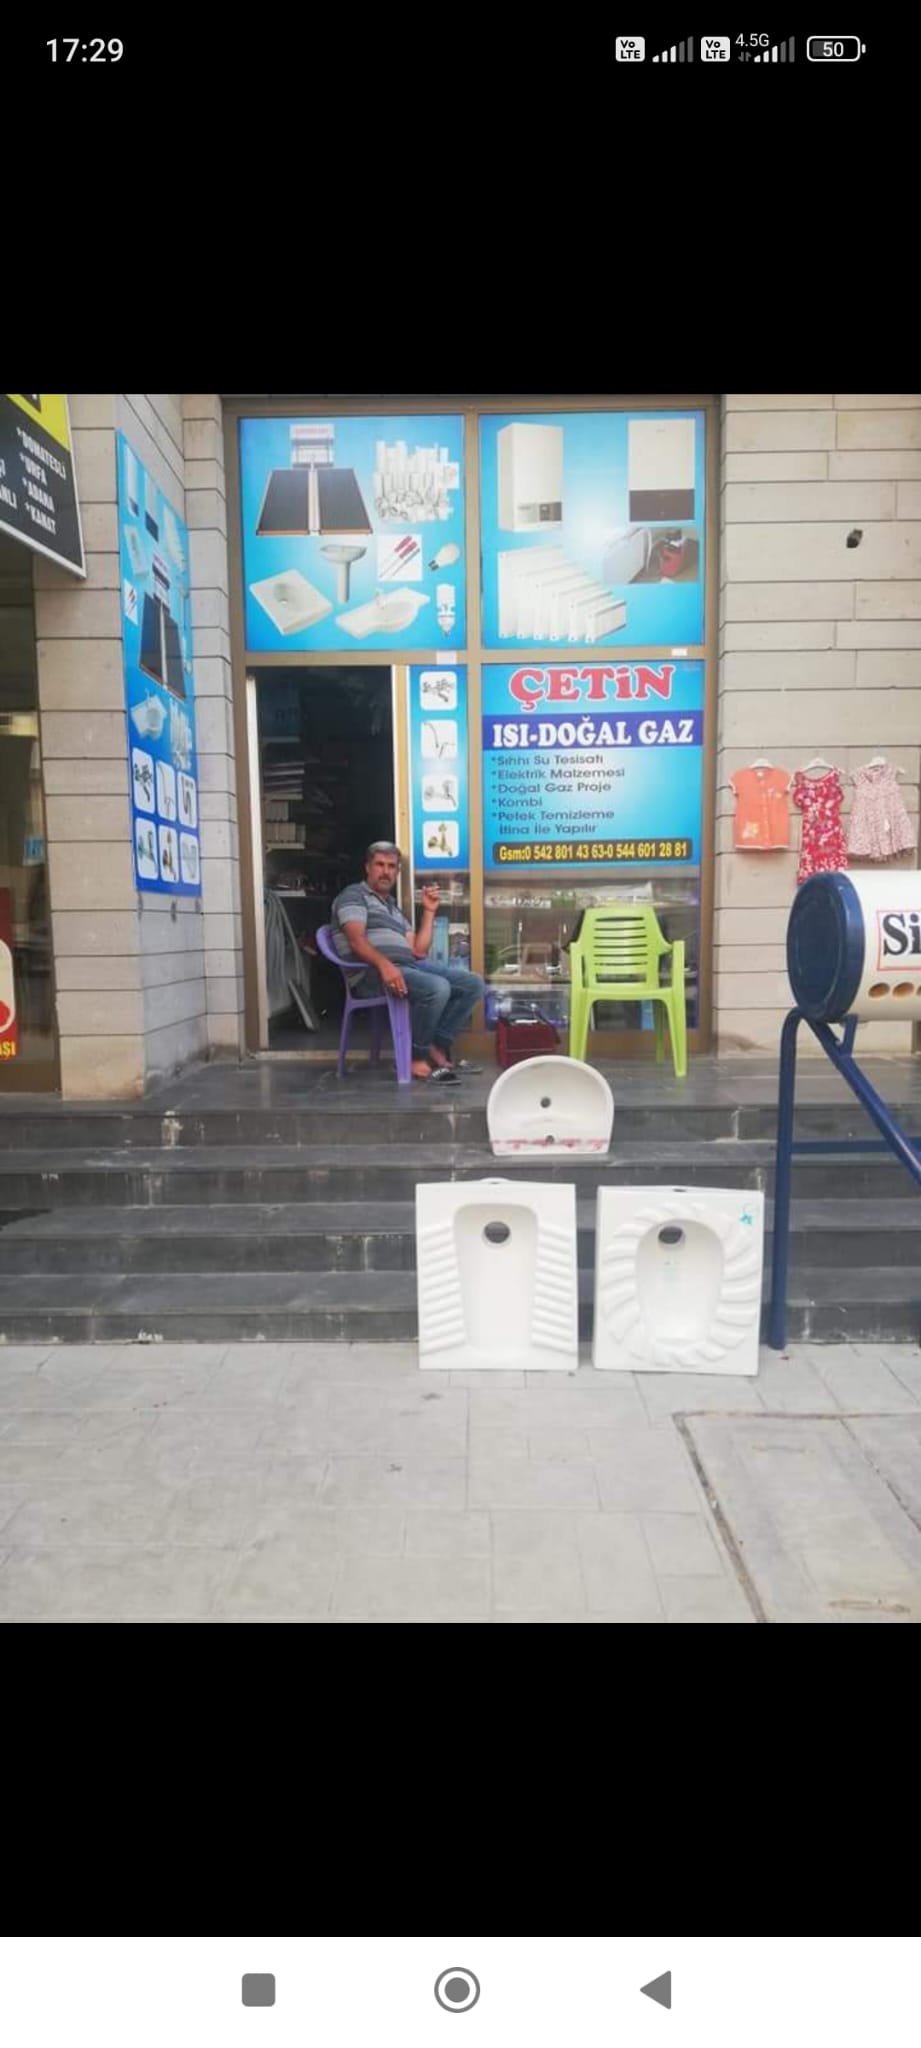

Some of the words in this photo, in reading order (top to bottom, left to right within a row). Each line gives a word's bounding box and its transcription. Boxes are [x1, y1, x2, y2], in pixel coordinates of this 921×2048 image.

[493, 716, 631, 747] ISI-DOĞAL
[638, 719, 694, 744] GAZ
[534, 755, 550, 765] Su
[498, 769, 546, 779] Elektrik
[550, 767, 625, 778] Malzemesi
[498, 783, 540, 794] Doğal
[545, 782, 573, 792] Gaz
[577, 782, 611, 793] Proje
[498, 797, 543, 807] Kombi
[498, 811, 535, 821] Petek
[540, 810, 615, 821] Temizleme
[500, 846, 531, 860] Gsm:0
[534, 845, 553, 859] 542
[555, 845, 573, 859] 801
[576, 845, 589, 858] 43
[591, 844, 614, 858] 63-0
[616, 843, 635, 858] 544
[637, 843, 656, 857] 601
[659, 842, 672, 857] 28
[674, 841, 688, 856] 81
[883, 913, 921, 956] Si
